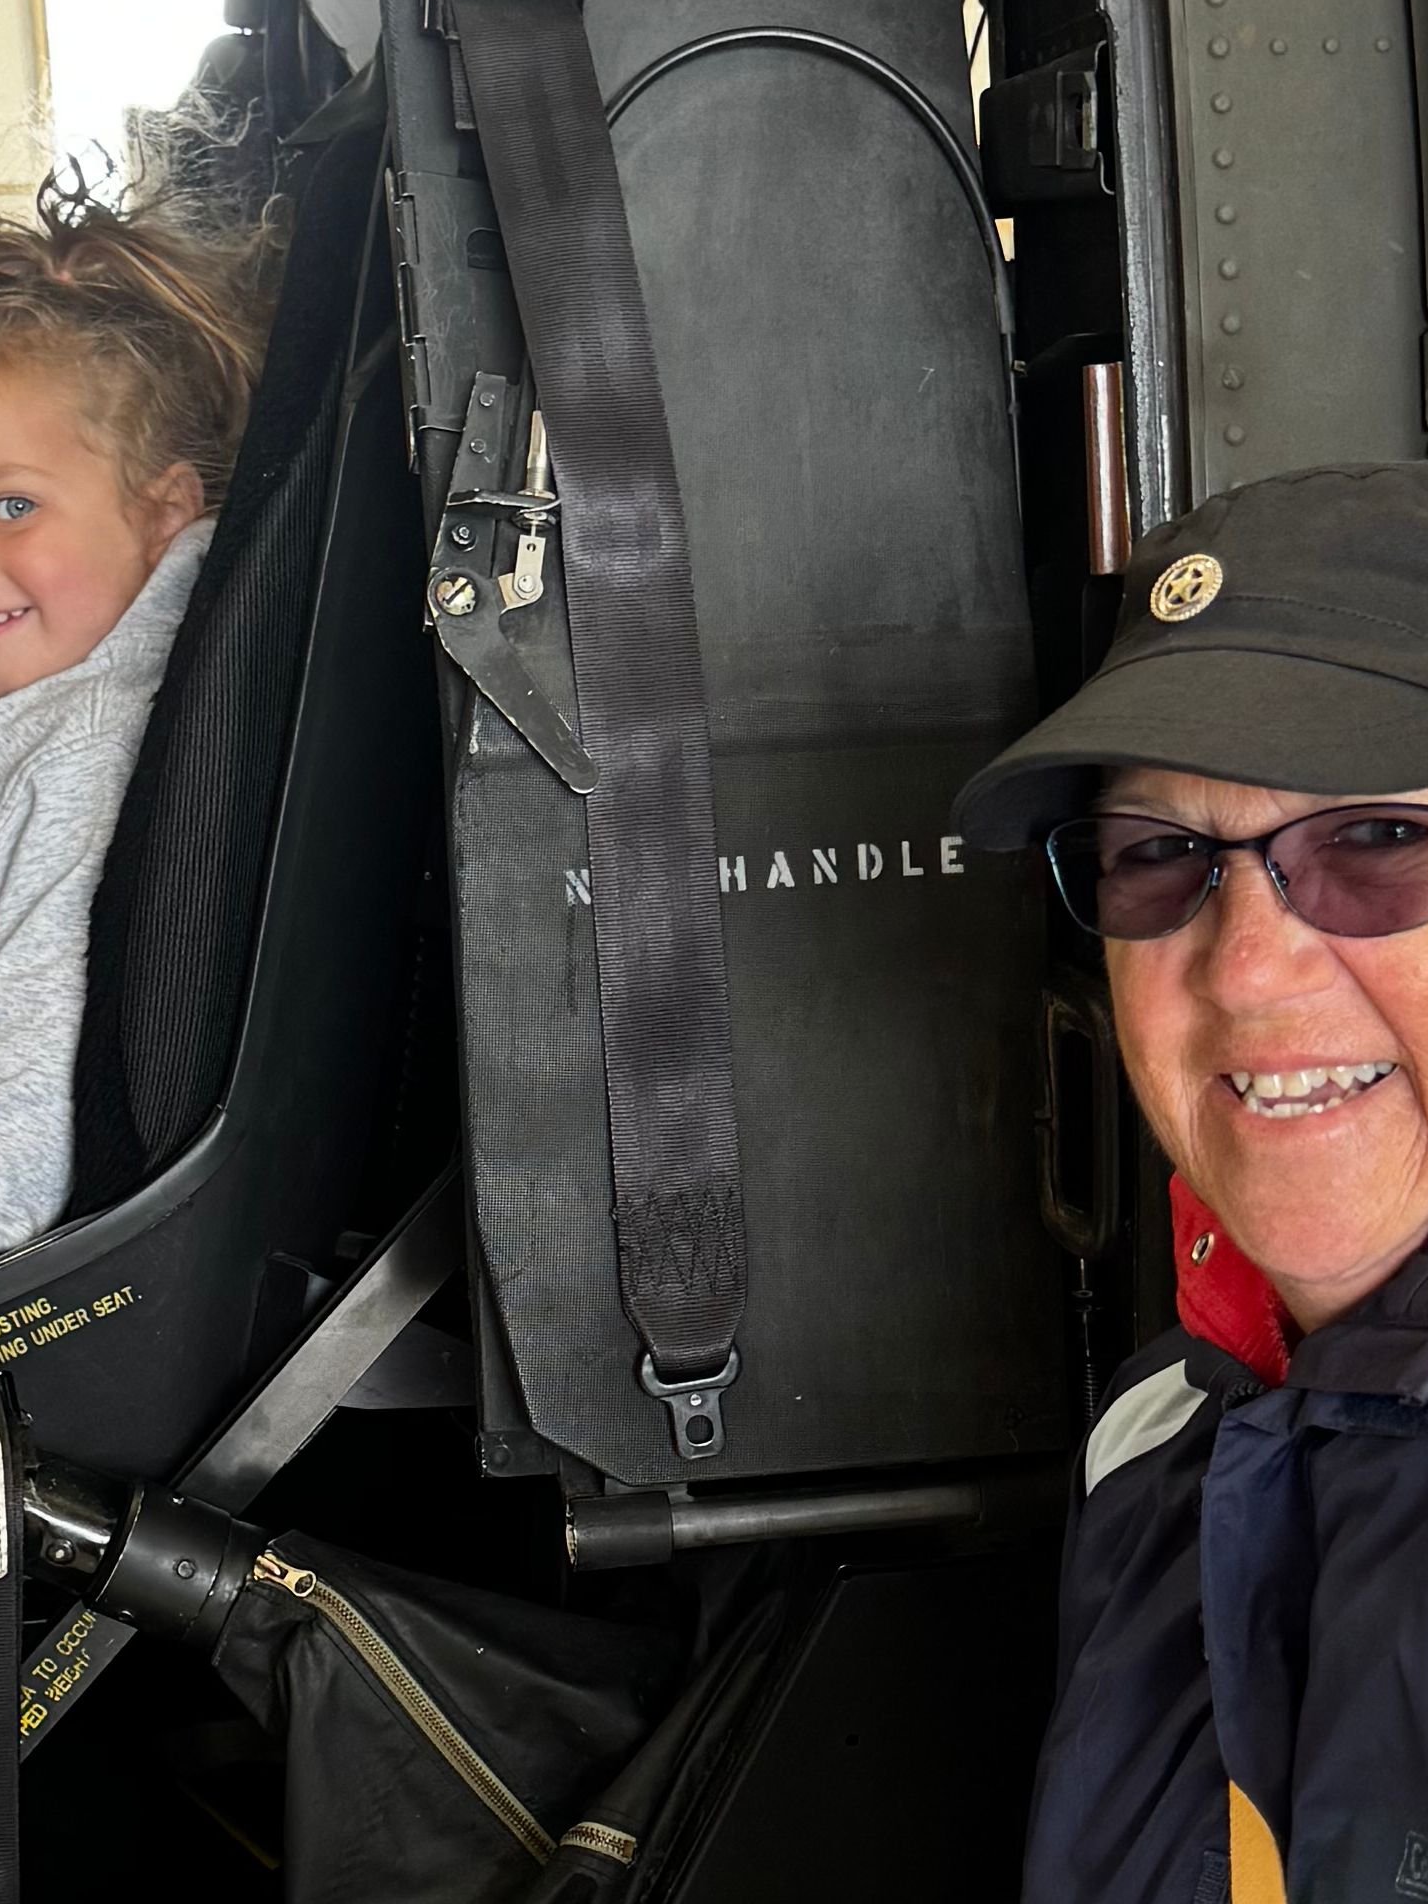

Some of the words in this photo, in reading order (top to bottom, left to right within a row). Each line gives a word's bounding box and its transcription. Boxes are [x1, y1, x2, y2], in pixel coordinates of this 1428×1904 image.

[719, 836, 965, 893] HANDLE
[30, 1308, 92, 1347] UNDER
[92, 1285, 143, 1319] SEAT.
[32, 1658, 58, 1681] TO
